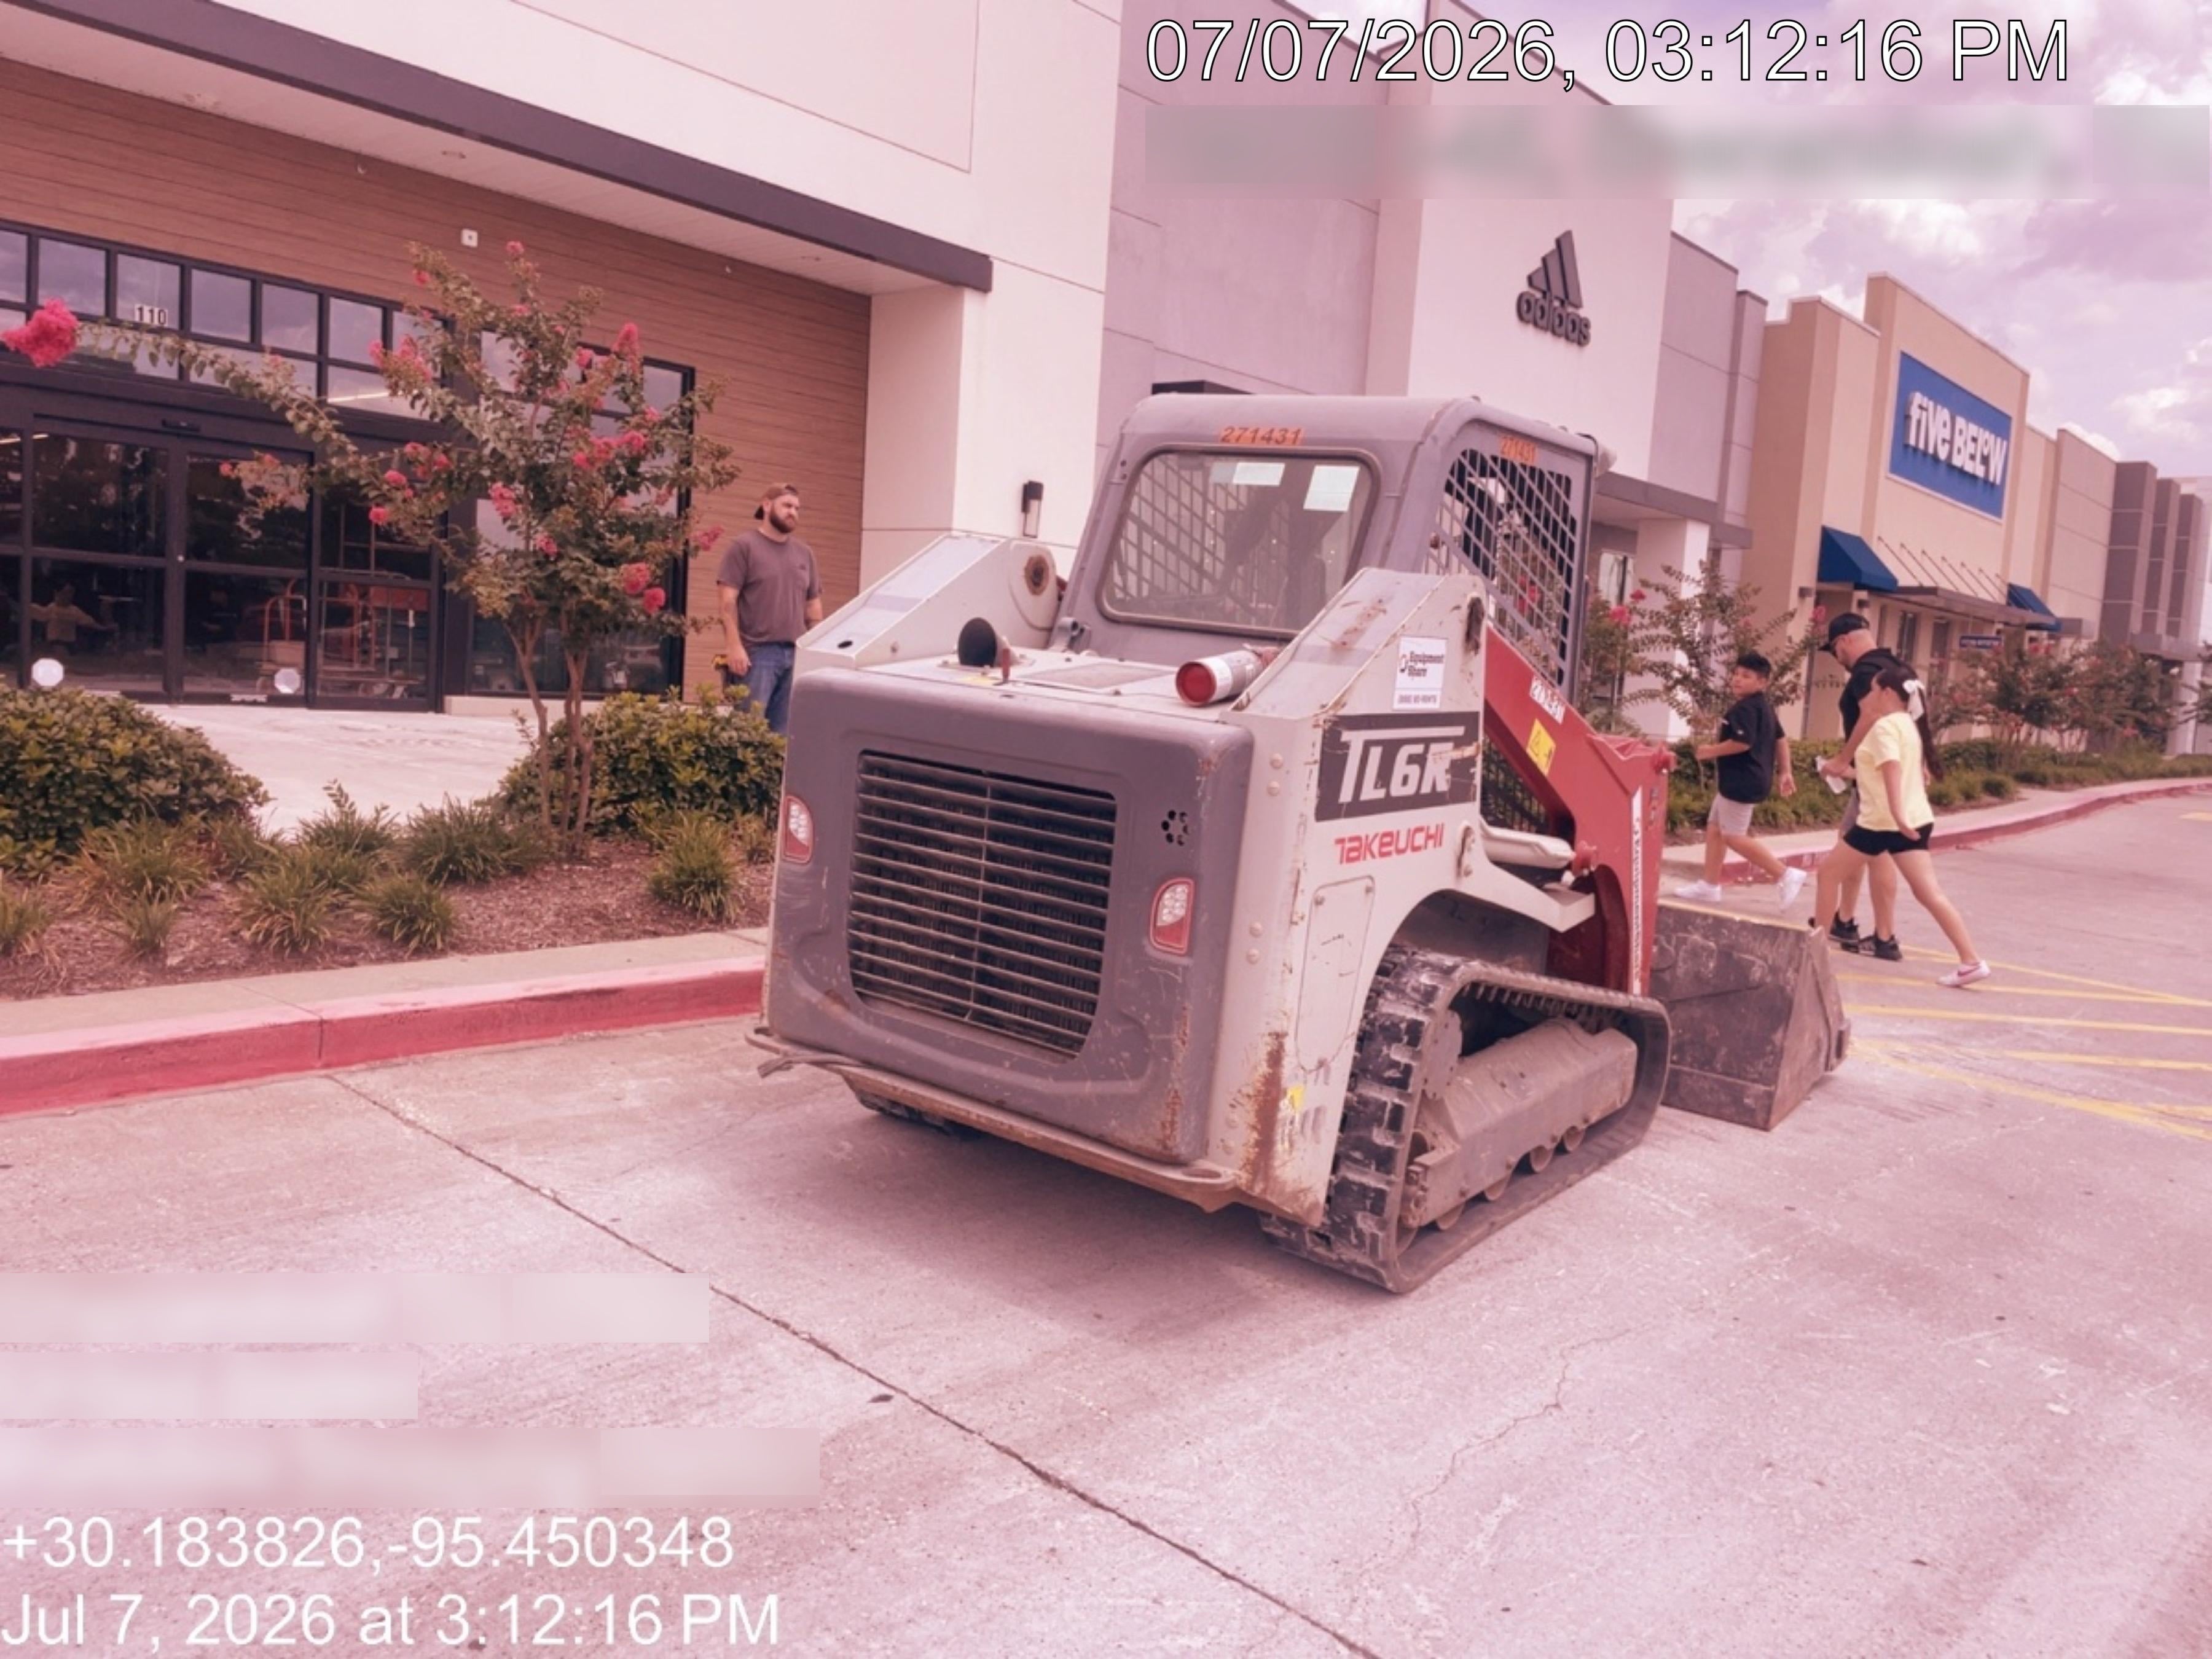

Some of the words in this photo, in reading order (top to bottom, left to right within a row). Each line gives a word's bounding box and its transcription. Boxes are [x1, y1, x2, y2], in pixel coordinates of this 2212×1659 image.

[137, 306, 167, 325] 110
[1516, 289, 1591, 347] adidas
[1220, 426, 1302, 445] 271431
[1906, 391, 1951, 461] five
